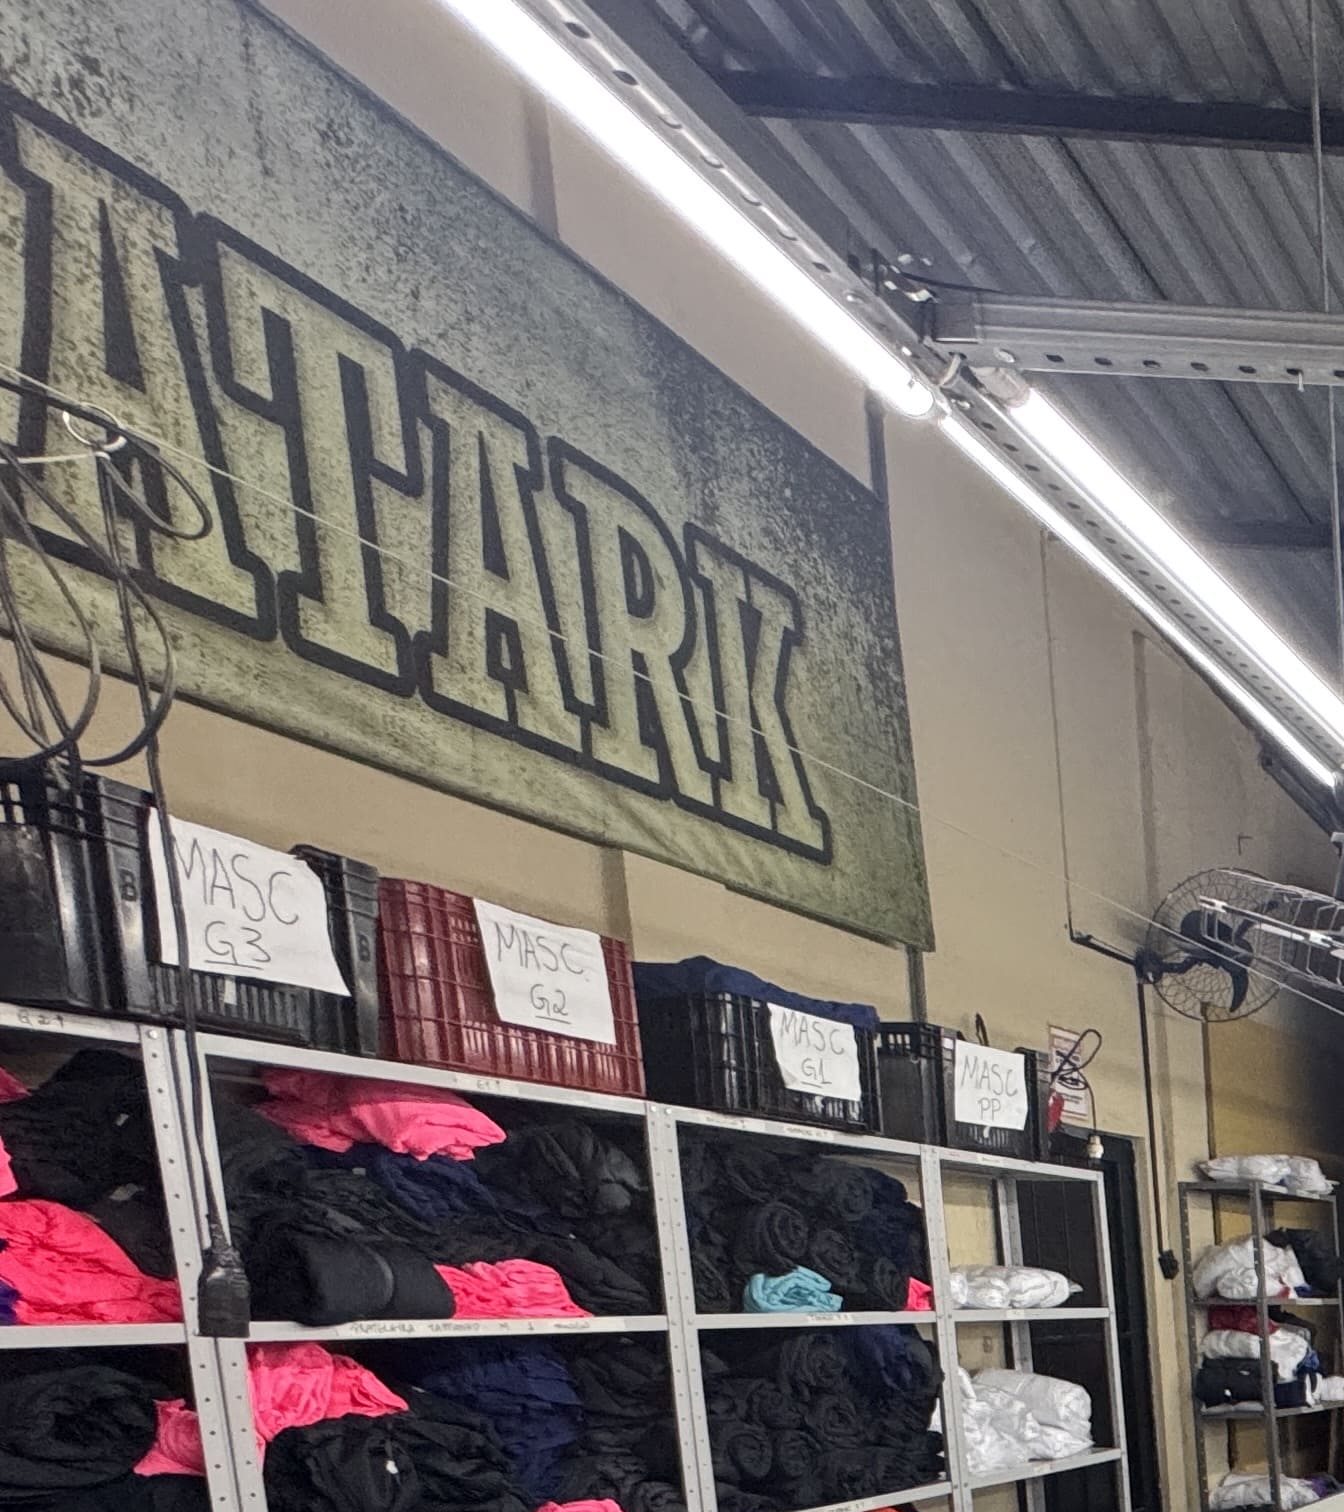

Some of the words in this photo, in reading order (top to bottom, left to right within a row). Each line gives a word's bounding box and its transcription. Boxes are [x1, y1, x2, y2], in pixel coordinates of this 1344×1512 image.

[172, 836, 299, 924] MASC
[204, 920, 271, 965] G3
[530, 983, 569, 1019] G2
[780, 1011, 845, 1055] MASC
[801, 1058, 832, 1085] G1
[960, 1055, 1019, 1097] MASC
[977, 1096, 1001, 1121] PP
